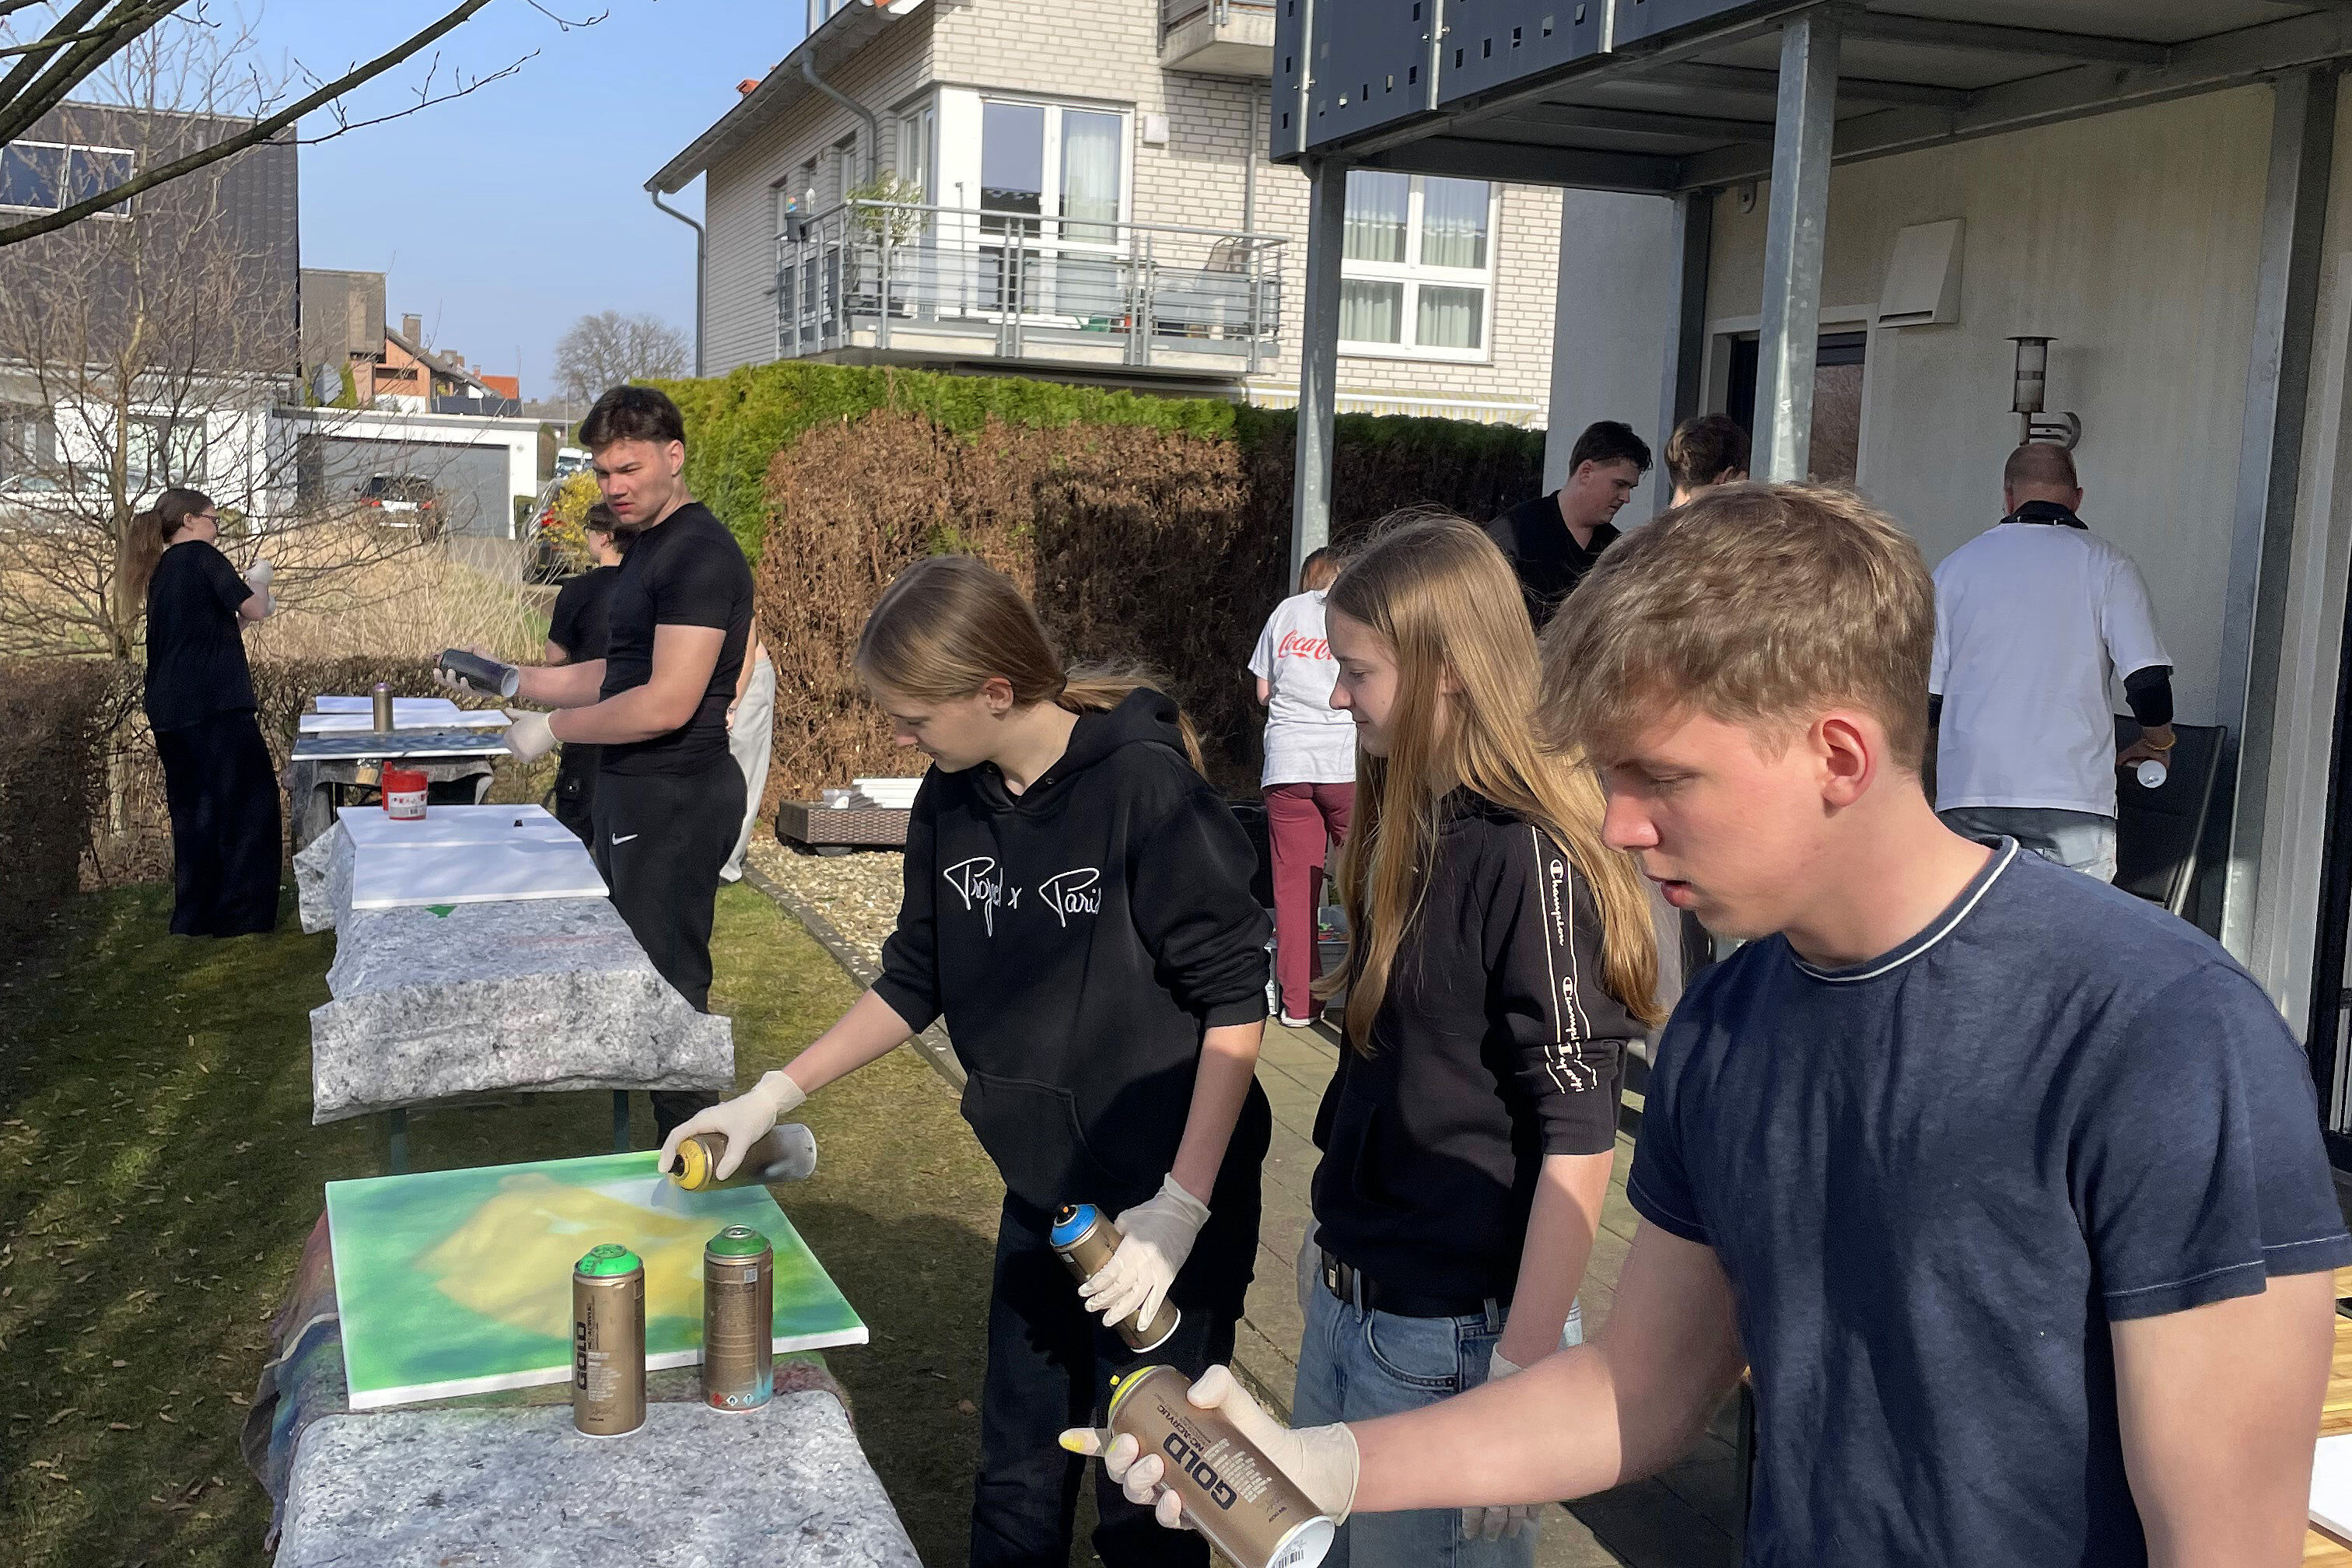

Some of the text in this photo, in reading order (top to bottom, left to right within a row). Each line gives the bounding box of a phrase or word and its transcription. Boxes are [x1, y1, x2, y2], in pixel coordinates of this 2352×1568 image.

[1549, 859, 1566, 947] Champion
[577, 1321, 587, 1391] GOLD
[1162, 1431, 1238, 1512] GOLD
